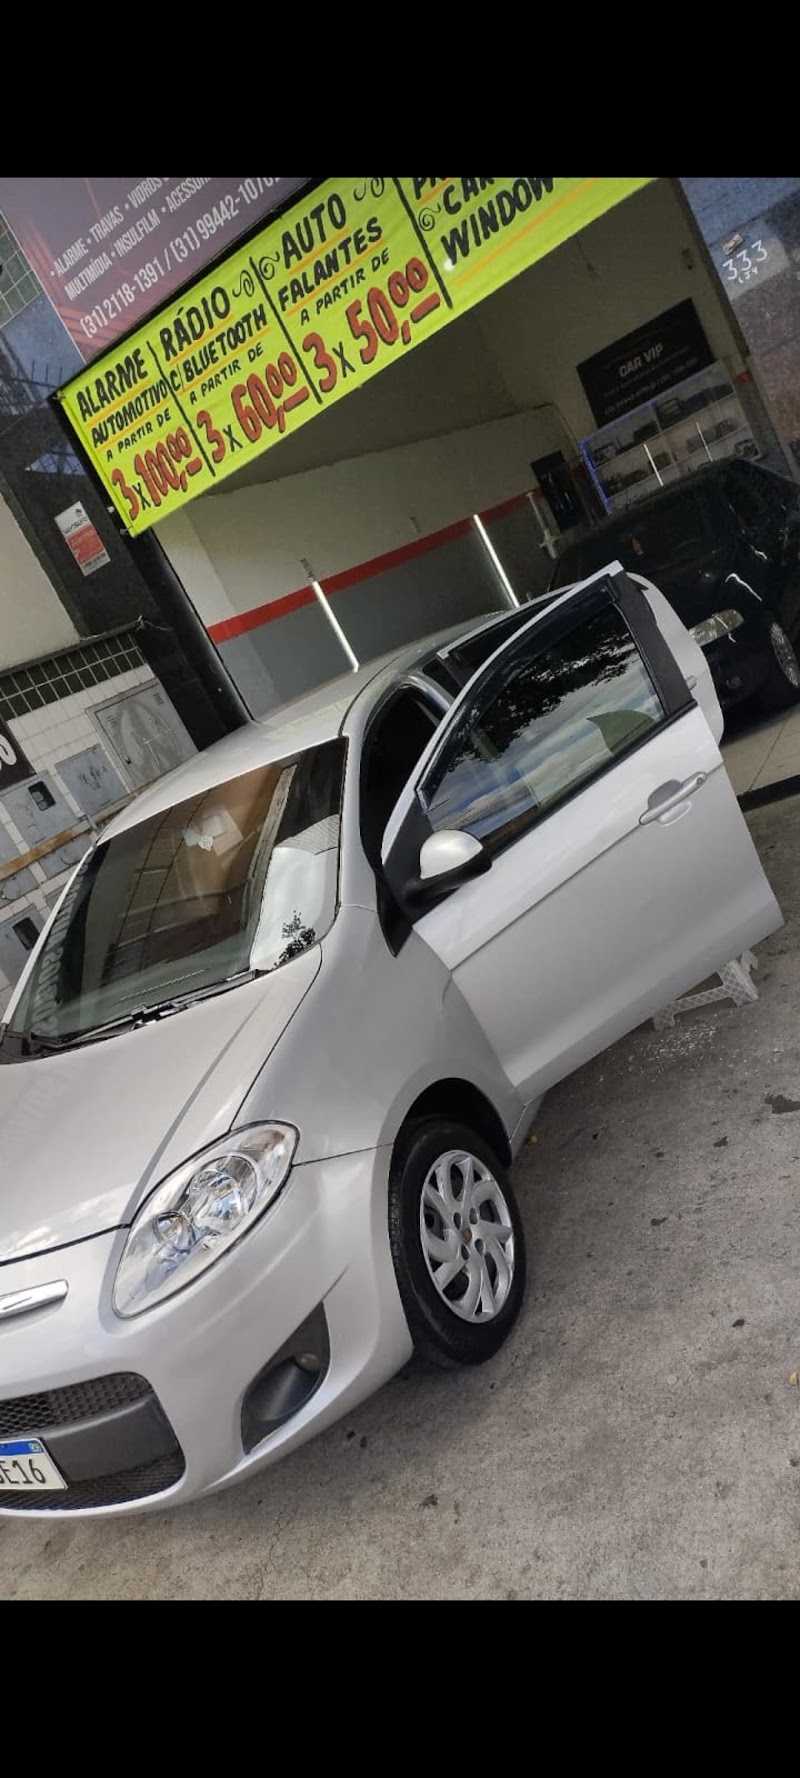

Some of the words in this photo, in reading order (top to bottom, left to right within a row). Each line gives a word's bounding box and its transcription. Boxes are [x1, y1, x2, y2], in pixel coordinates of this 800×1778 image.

[54, 238, 89, 275] ALARME
[89, 206, 124, 243] TRAVAS
[127, 178, 163, 210] VIDROS
[64, 252, 113, 301] MULTIMÍDIA
[114, 209, 161, 257] INSULFILM
[281, 193, 346, 269] AUTO
[80, 305, 105, 338] (31)
[104, 257, 164, 319] 2118-1391
[169, 227, 199, 263] (31)
[278, 217, 382, 312] FALANTES
[301, 308, 310, 326] A
[316, 268, 366, 315] PARTIR
[371, 247, 389, 272] DE
[160, 286, 231, 362] RÁDIO
[76, 348, 149, 422] ALARME
[190, 391, 197, 405] A
[201, 360, 241, 398] PARTIR
[248, 342, 264, 362] DE
[302, 332, 338, 393] 3
[618, 359, 643, 378] CAR
[643, 343, 664, 363] VIP
[91, 380, 168, 448] AUTOMOTIVO
[106, 449, 113, 462] A
[117, 422, 154, 453] PARTIR
[156, 408, 171, 427] DE
[196, 410, 226, 464] 3
[111, 468, 139, 521] 3
[0, 1459, 46, 1484] E16
